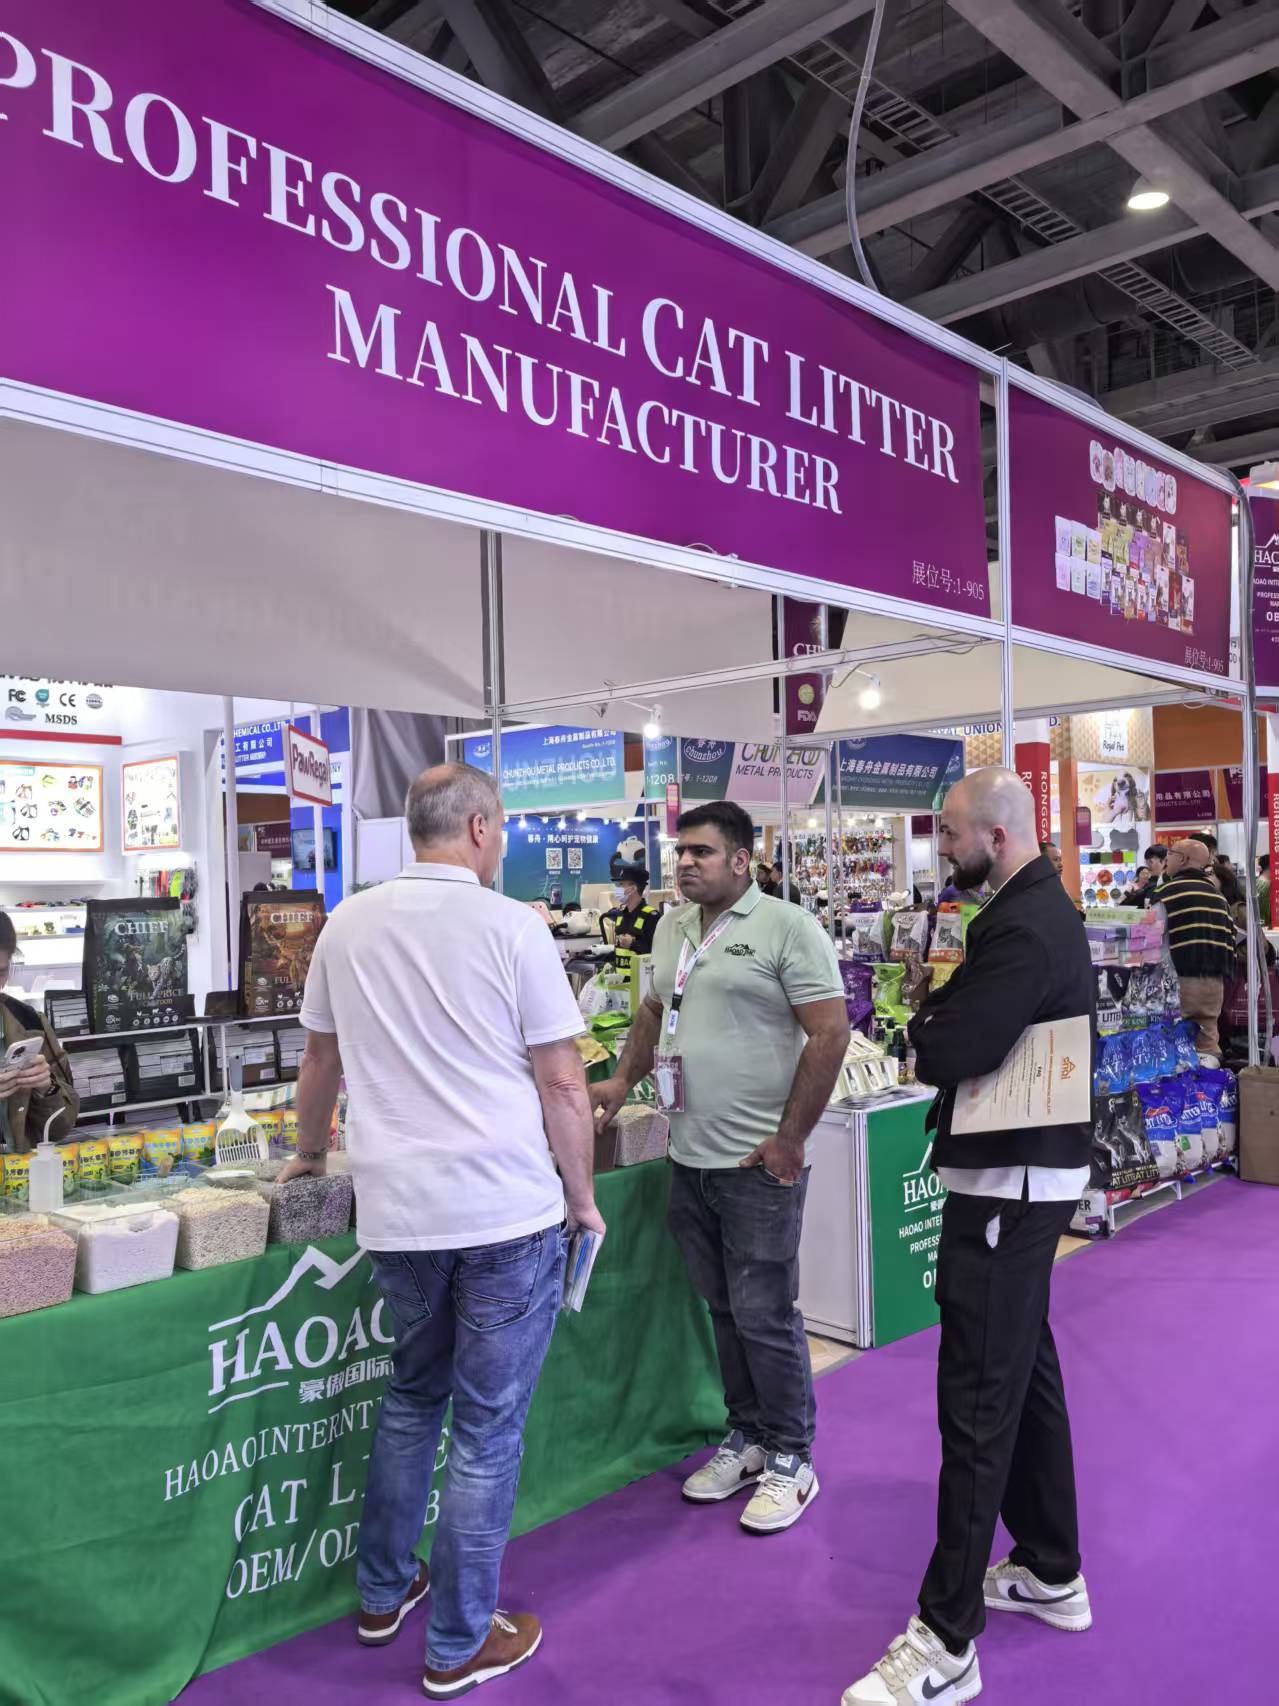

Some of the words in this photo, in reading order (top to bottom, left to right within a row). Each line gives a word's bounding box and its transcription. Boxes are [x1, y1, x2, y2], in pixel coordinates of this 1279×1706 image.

[326, 284, 843, 514] MANUFACTURER
[642, 297, 768, 406] CAT
[785, 350, 959, 483] LITTER
[912, 560, 985, 600] 展位号:1-905
[45, 713, 78, 725] MSDS
[736, 764, 765, 777] METAL
[840, 757, 939, 780] 上海春舟金属制品有限公司
[1040, 771, 1049, 843] RONGGA
[114, 920, 169, 936] CHIEF
[270, 911, 315, 924] CHIEF
[899, 1221, 922, 1239] HAOAO
[234, 1478, 308, 1543] CAT
